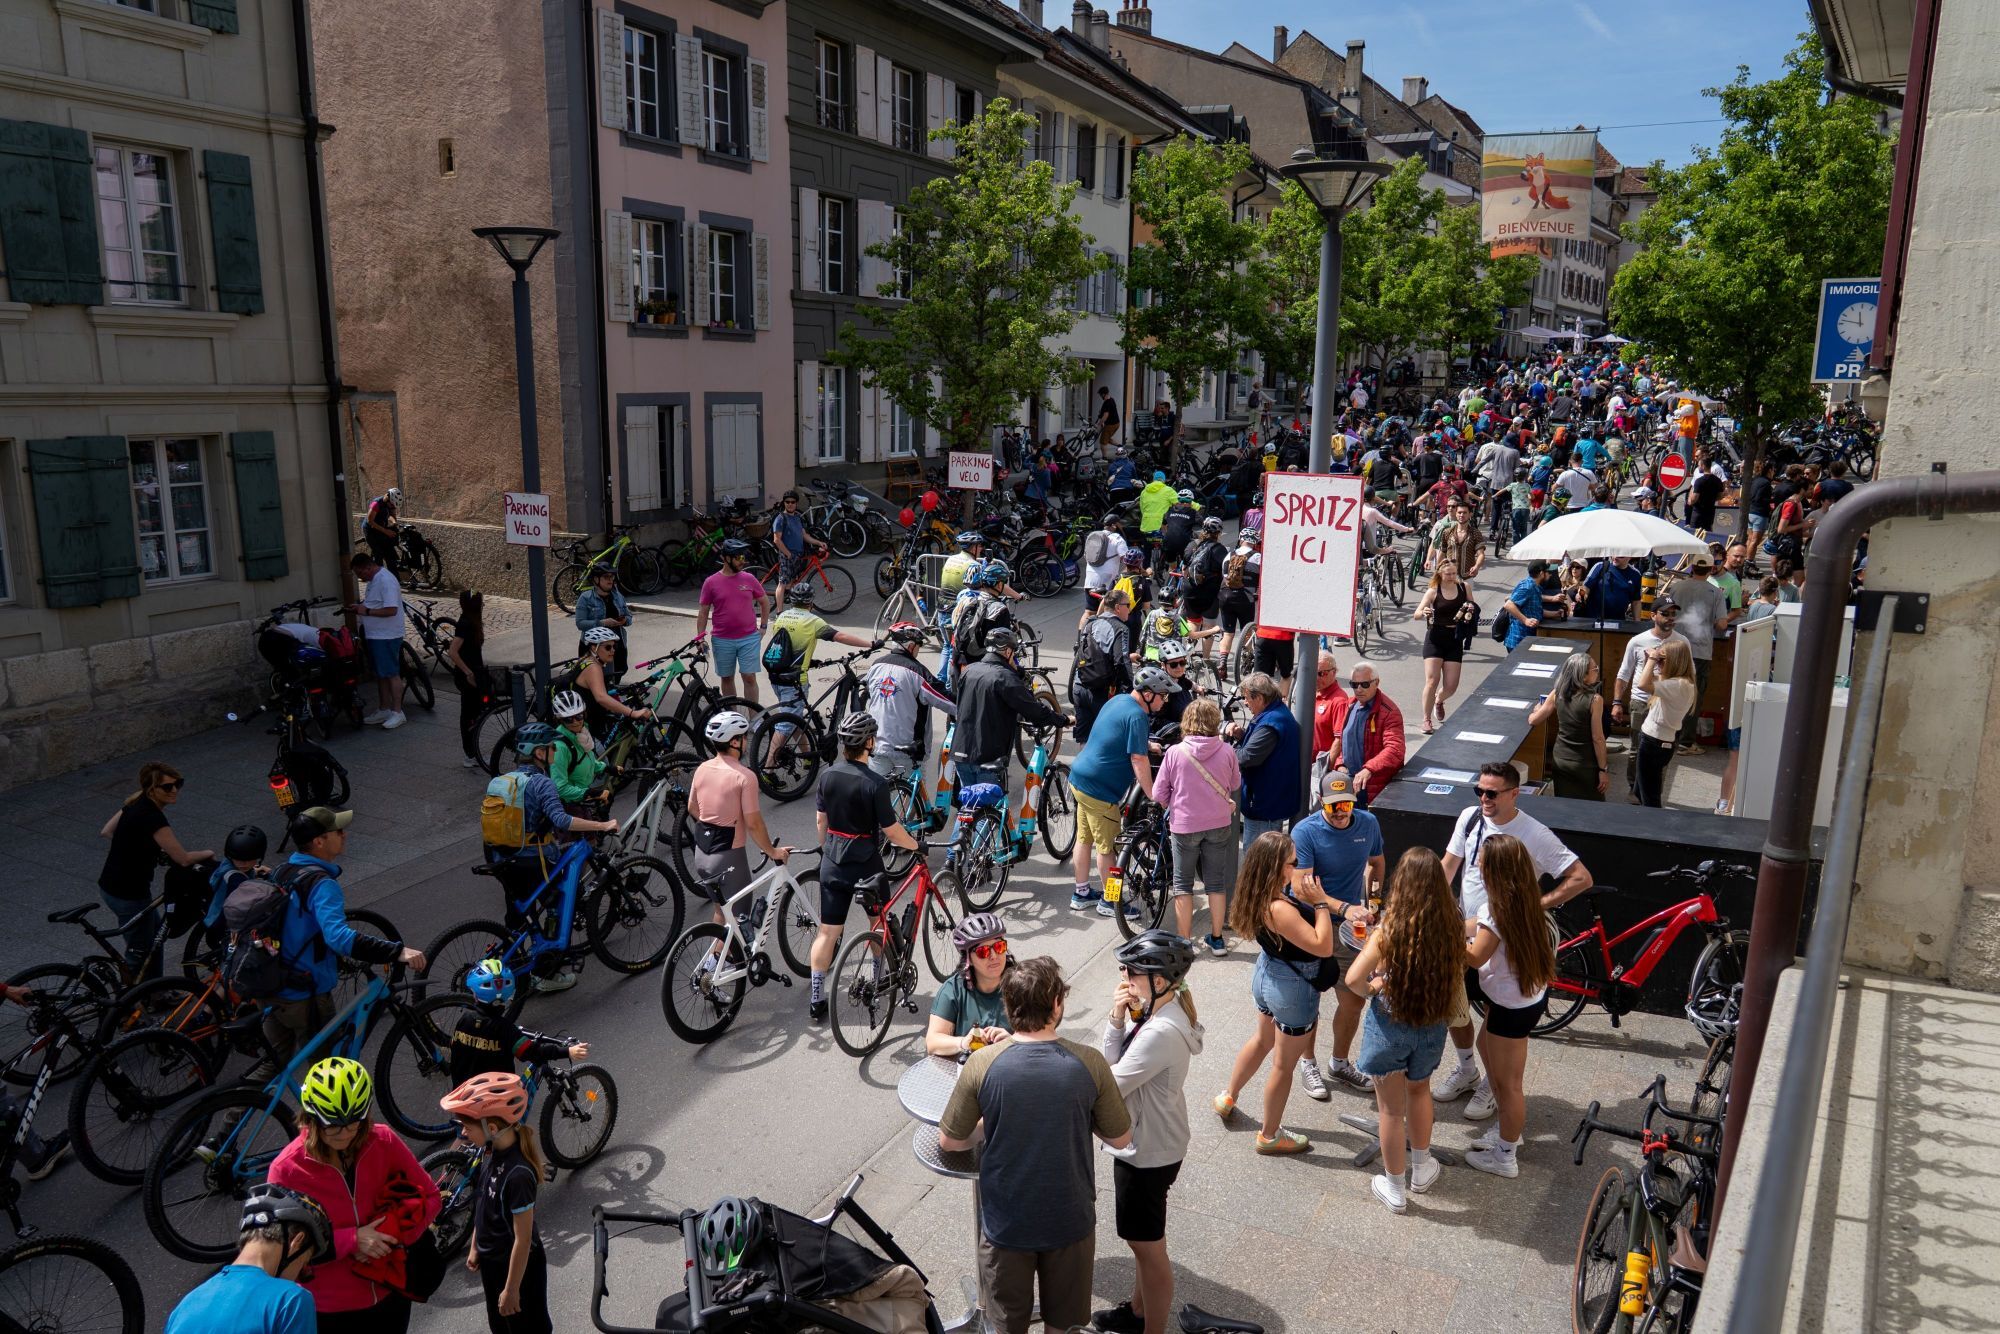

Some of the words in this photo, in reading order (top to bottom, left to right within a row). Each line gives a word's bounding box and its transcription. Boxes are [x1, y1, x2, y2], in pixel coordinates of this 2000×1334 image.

[1498, 221, 1575, 235] BIENVENUE
[951, 455, 991, 469] PARKING
[959, 471, 980, 482] VELO
[1273, 493, 1358, 532] SPRITZ
[1291, 534, 1327, 564] ICI
[454, 1030, 502, 1052] PORTUGAL
[729, 1305, 750, 1316] THULE
